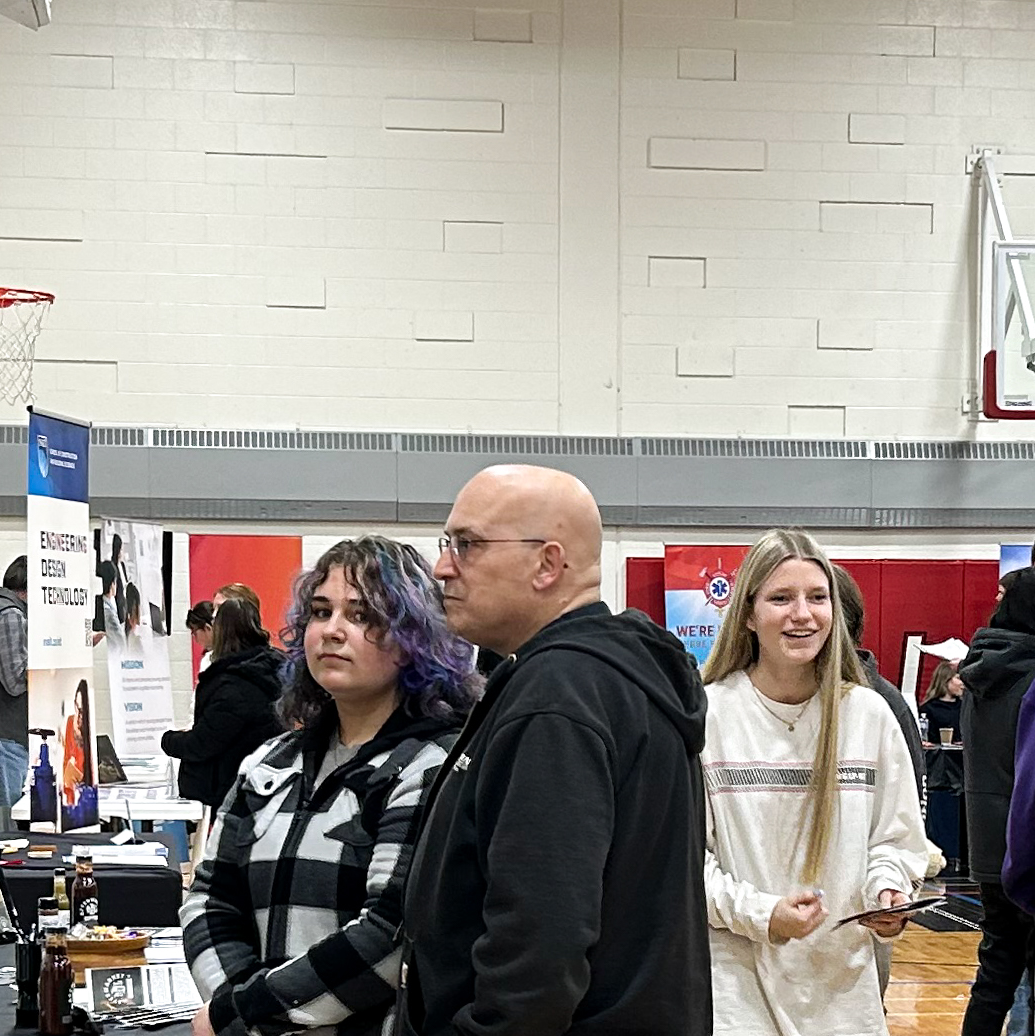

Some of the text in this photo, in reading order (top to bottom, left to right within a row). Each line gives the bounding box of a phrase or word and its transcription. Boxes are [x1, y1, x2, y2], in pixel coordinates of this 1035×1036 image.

[40, 530, 88, 554] ENGINEERING
[41, 558, 67, 578] DESIGN
[41, 586, 89, 606] TECHNOLOGY
[676, 624, 715, 638] WE'RE
